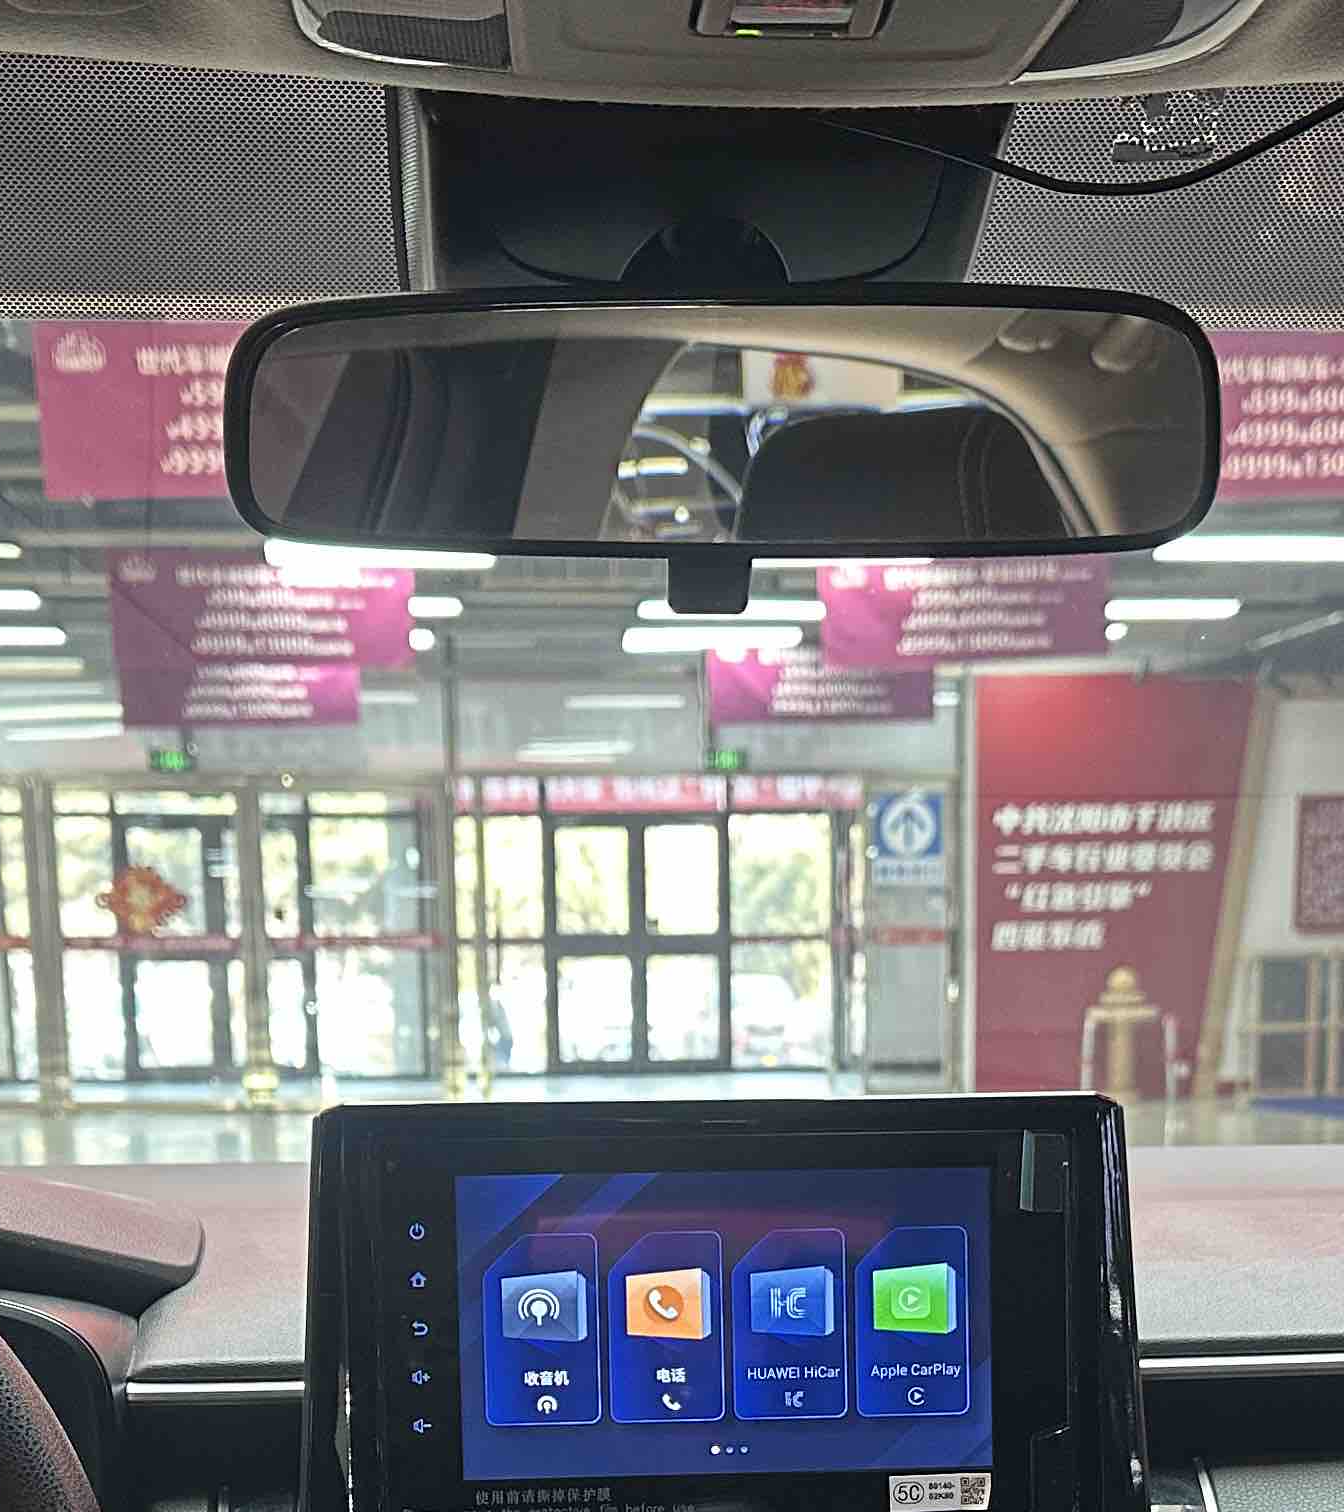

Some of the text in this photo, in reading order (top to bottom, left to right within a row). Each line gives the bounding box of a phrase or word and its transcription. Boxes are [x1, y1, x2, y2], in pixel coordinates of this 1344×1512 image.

[524, 1370, 570, 1387] 收音机
[655, 1367, 687, 1384] 电话
[747, 1365, 841, 1381] HUAWEI HiCar
[870, 1362, 962, 1383] Apple CarPlay
